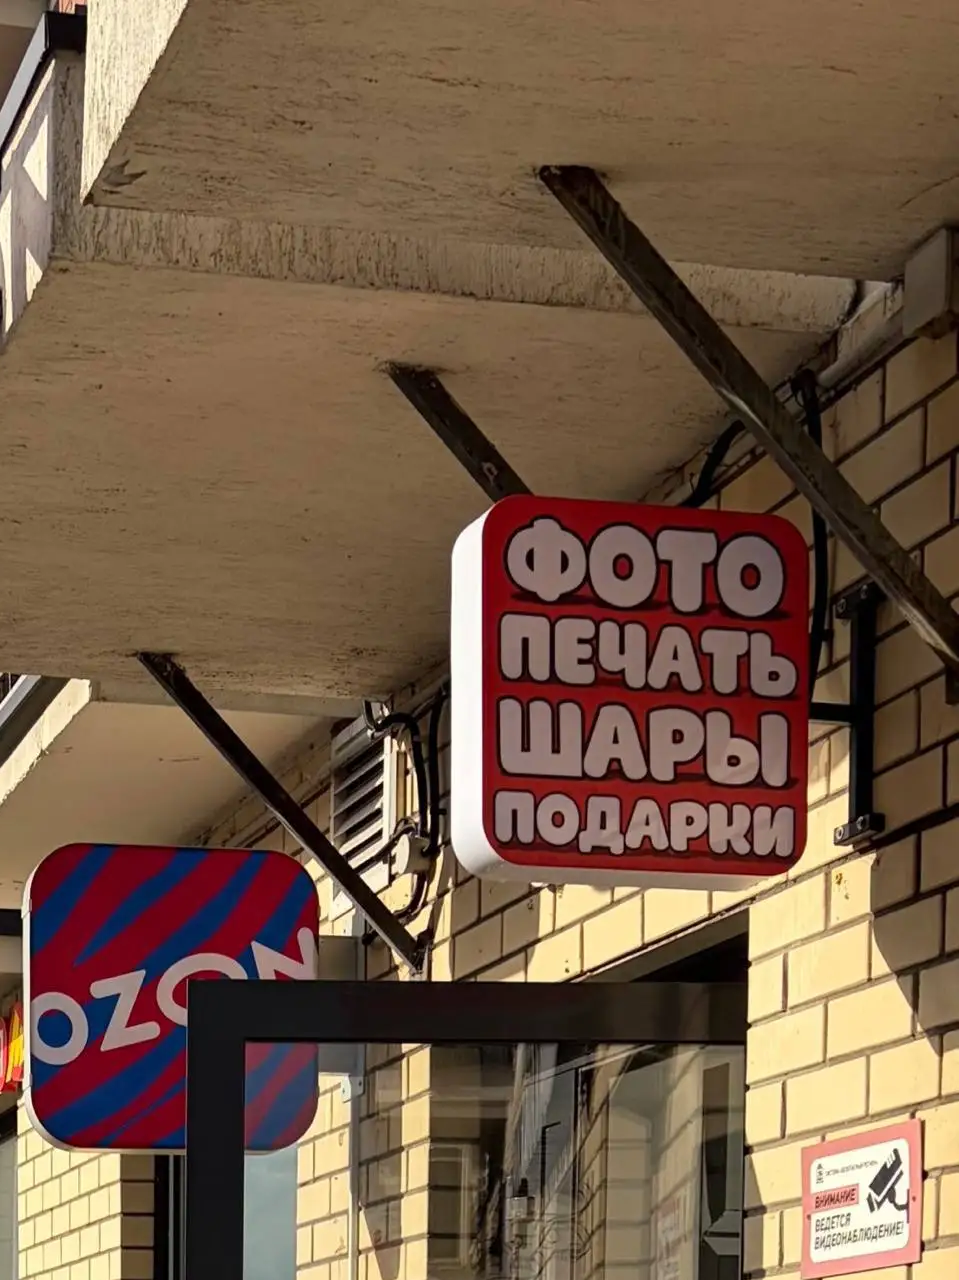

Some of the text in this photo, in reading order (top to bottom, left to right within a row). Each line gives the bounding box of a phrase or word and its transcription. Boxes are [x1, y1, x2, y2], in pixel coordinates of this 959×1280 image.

[506, 517, 785, 618] ФОТО
[499, 613, 797, 698] ПЕЧАТЬ
[497, 697, 789, 788] ШАРЫ
[494, 790, 795, 857] ПОДАРКИ
[815, 1188, 856, 1209] ВНИМАНИЕ
[815, 1212, 852, 1233] ВЕДЕТСЯ
[814, 1222, 904, 1250] ВИДЕОНАБЛЮДЕНИЕ!
